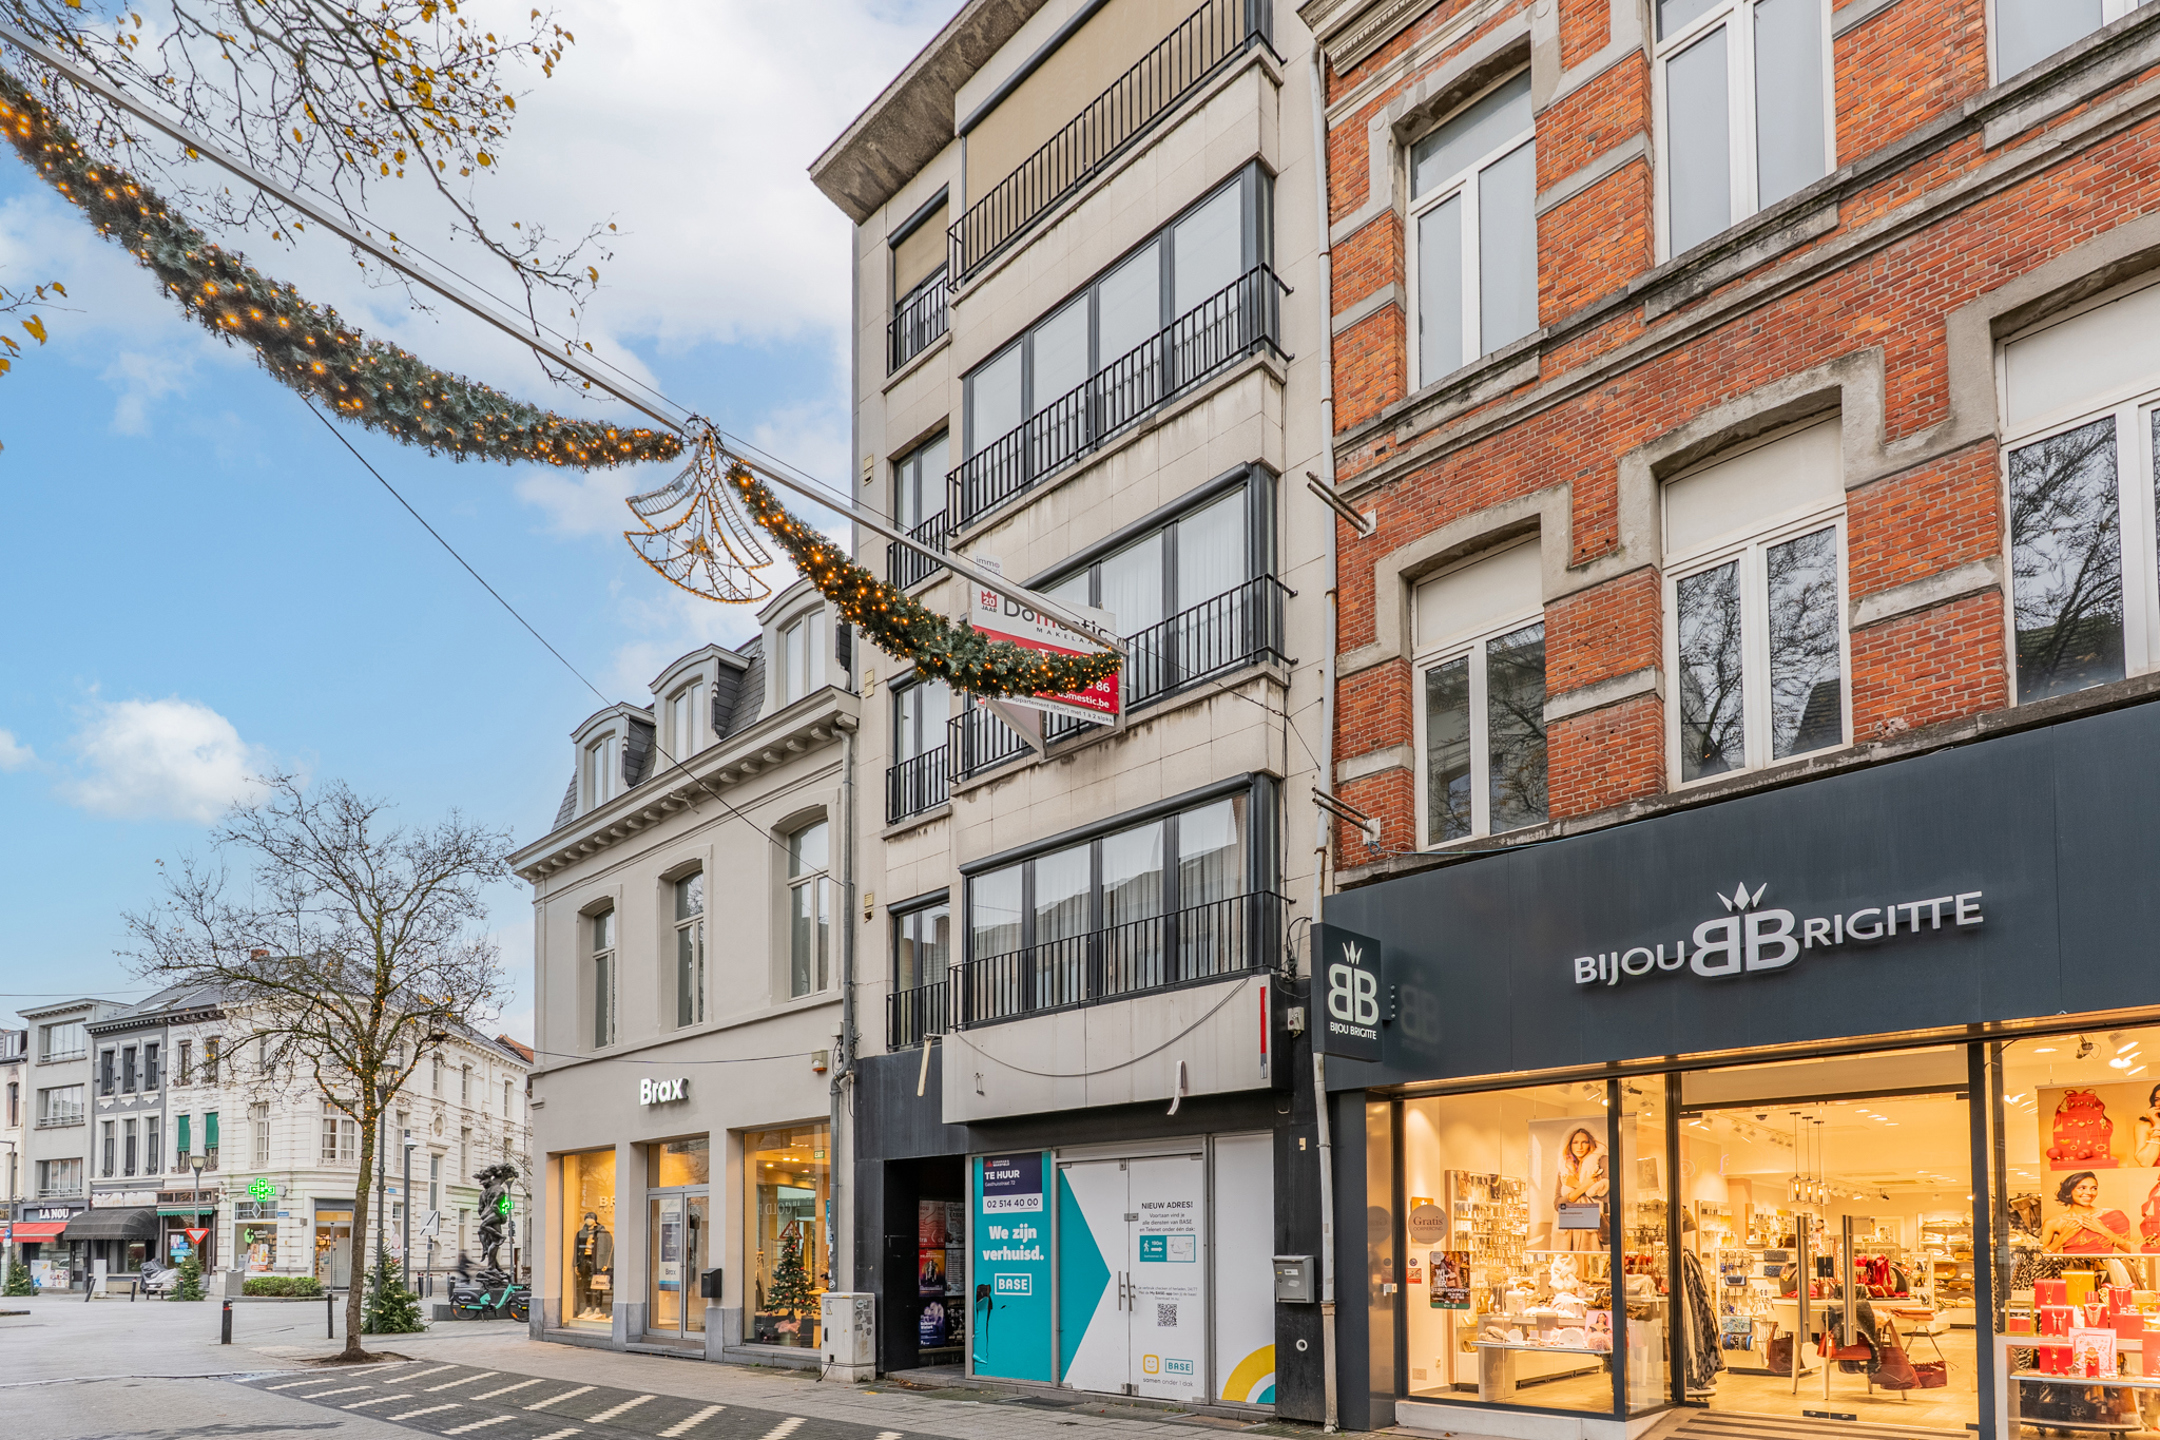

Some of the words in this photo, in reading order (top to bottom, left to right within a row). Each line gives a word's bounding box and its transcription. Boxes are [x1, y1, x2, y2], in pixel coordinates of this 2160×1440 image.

[976, 556, 1000, 569] immo
[983, 596, 996, 606] 20
[981, 605, 998, 613] JAAR
[1096, 681, 1111, 693] 86
[1574, 940, 1685, 986] BIJOU
[1330, 1021, 1349, 1035] BIJOU
[1350, 1025, 1377, 1040] BRIGITTE
[639, 1077, 687, 1106] Brax
[985, 1171, 996, 1180] TE
[996, 1170, 1020, 1180] HUUR
[987, 1200, 997, 1208] 02
[999, 1199, 1012, 1208] 514
[1014, 1198, 1025, 1207] 40
[1027, 1197, 1039, 1206] 00
[1166, 1201, 1193, 1209] ADRES!
[39, 1209, 50, 1219] LA
[51, 1208, 69, 1219] NOU
[988, 1225, 1009, 1240] We
[1012, 1223, 1037, 1243] zijn
[982, 1245, 1044, 1261] verhuisd.
[998, 1278, 1028, 1290] BASE
[1168, 1362, 1190, 1371] BASE
